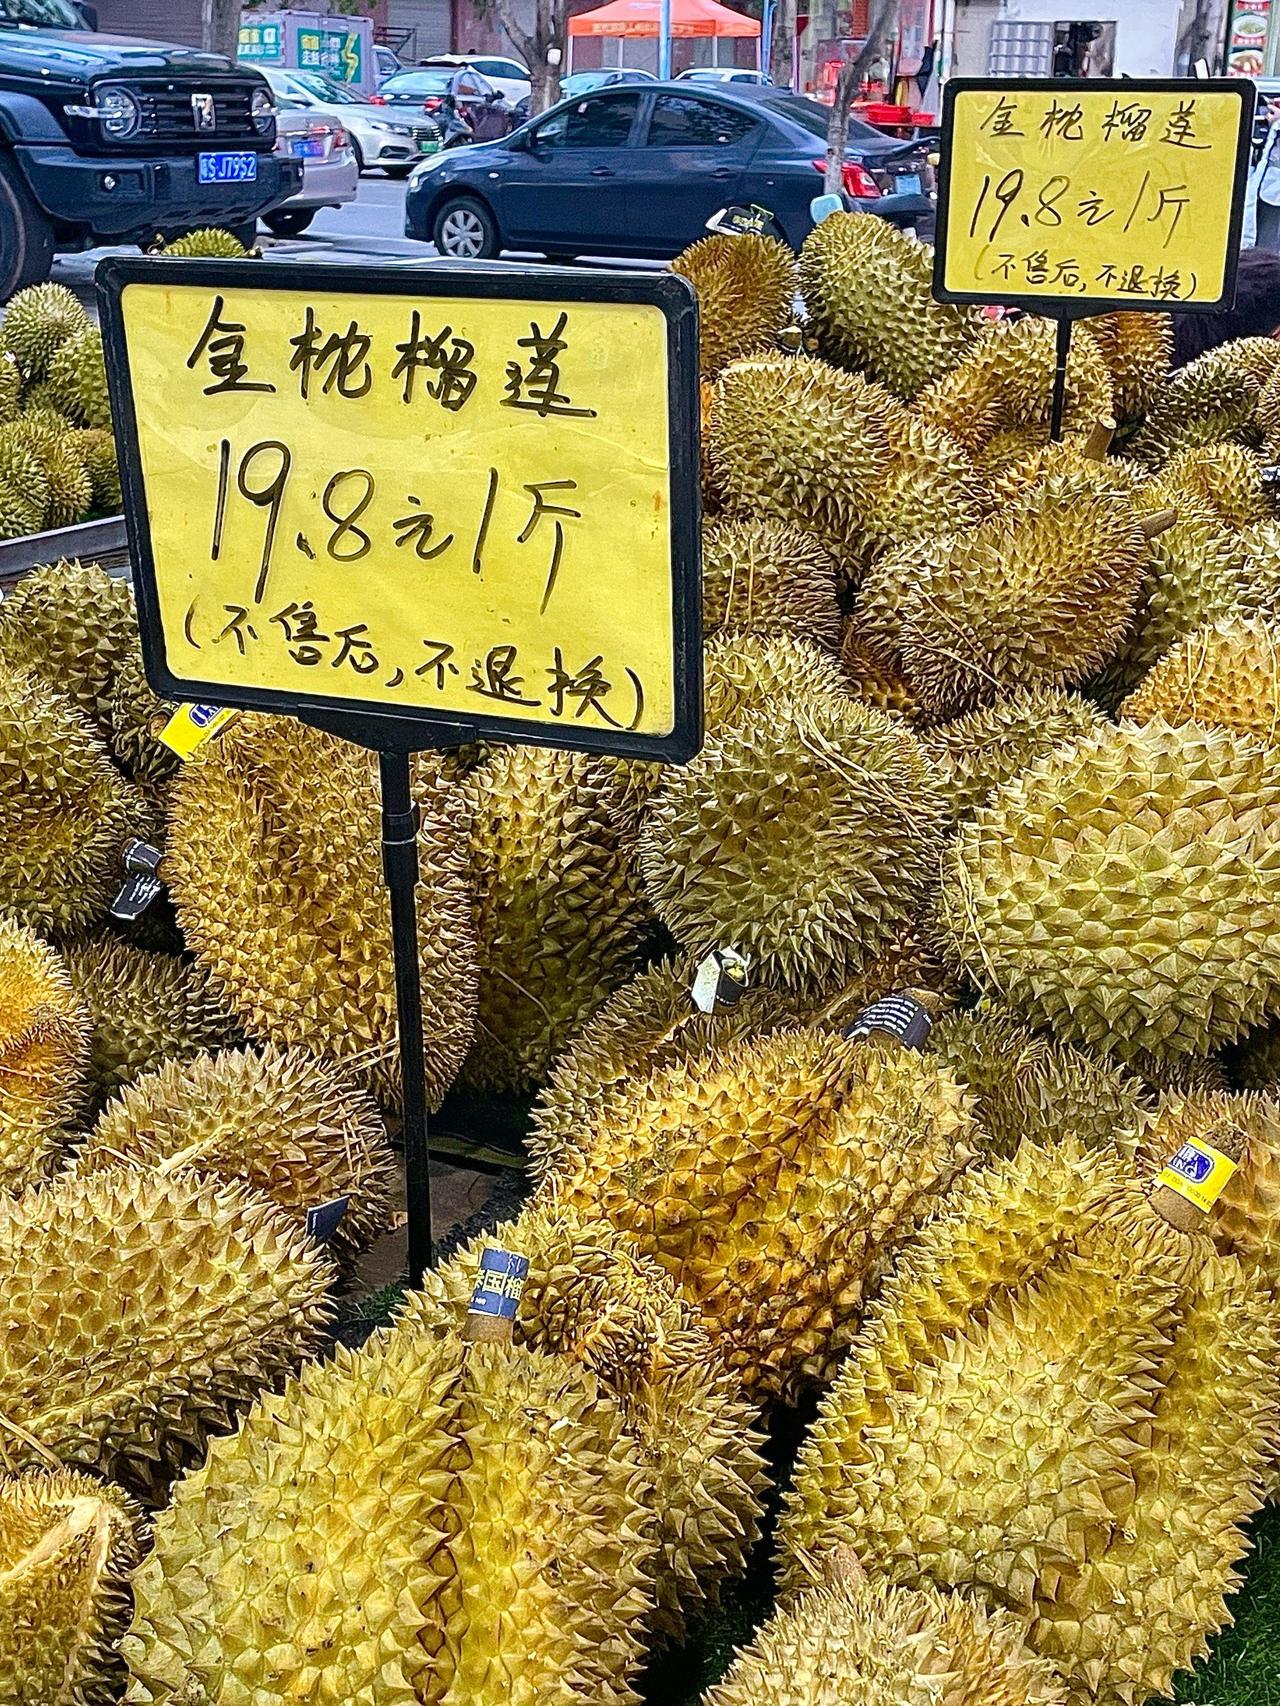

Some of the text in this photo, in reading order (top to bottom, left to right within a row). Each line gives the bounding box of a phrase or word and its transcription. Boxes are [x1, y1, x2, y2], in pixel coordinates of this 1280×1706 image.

[980, 96, 1213, 150] 金枕榴莲
[187, 295, 598, 418] 金枕榴莲
